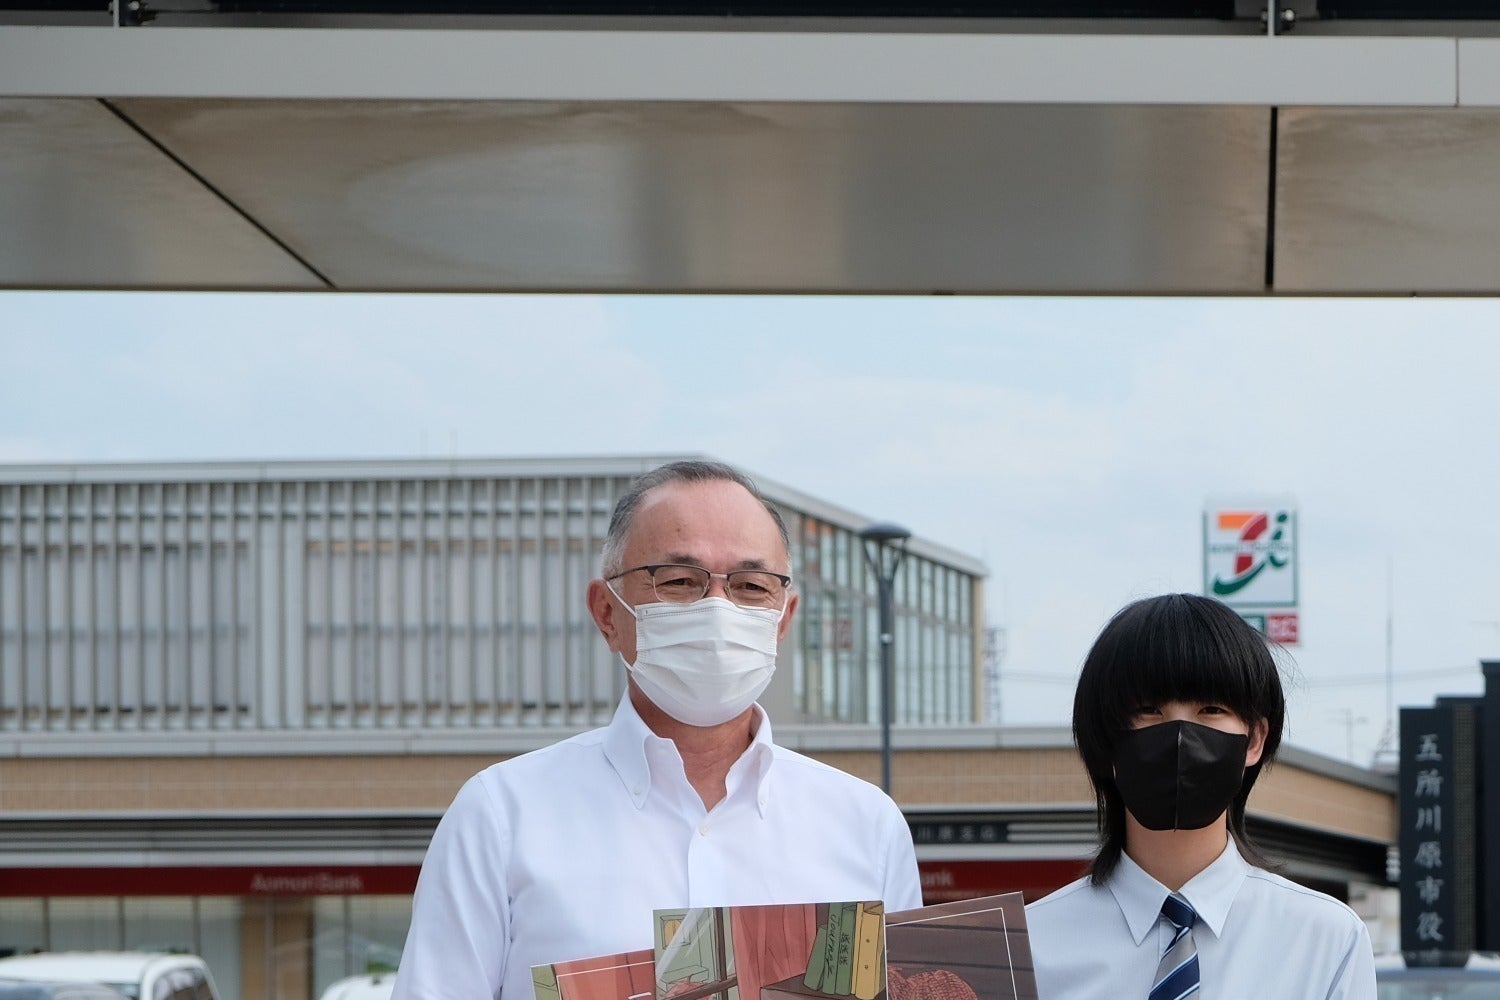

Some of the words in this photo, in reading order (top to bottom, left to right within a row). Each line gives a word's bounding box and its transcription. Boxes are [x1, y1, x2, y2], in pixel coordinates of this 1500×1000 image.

[1414, 733, 1444, 966] 五所川原市役
